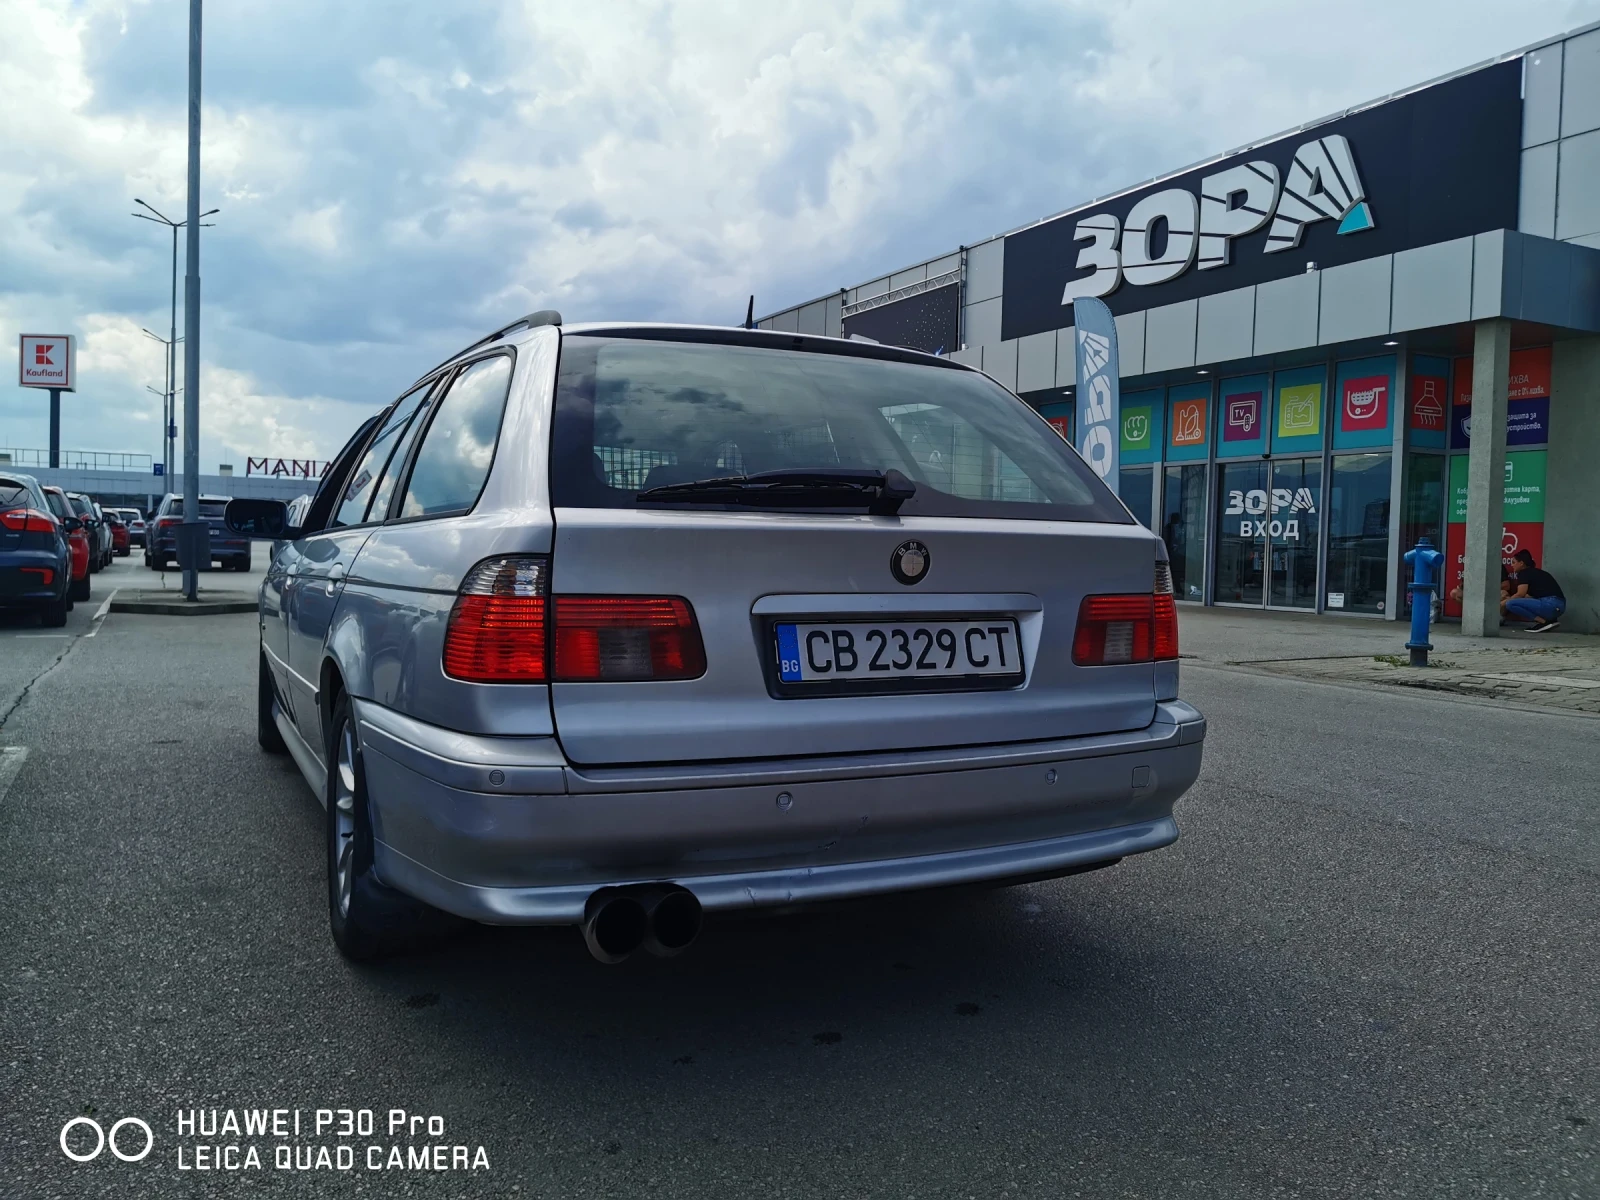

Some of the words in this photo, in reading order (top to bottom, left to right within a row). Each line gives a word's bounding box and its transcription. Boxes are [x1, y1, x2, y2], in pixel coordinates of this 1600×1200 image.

[1061, 134, 1375, 305] ЗОРА
[26, 368, 63, 377] Kaufland
[1508, 374, 1529, 385] ИХВА
[1079, 329, 1113, 479] ОРА
[1234, 409, 1245, 418] TV
[1224, 487, 1316, 515] ЗОРА
[1240, 519, 1300, 541] ВХОД
[898, 542, 927, 556] BMW
[805, 629, 858, 673] CB
[865, 627, 957, 671] 2329
[965, 627, 1009, 668] CT
[781, 659, 799, 673] BG
